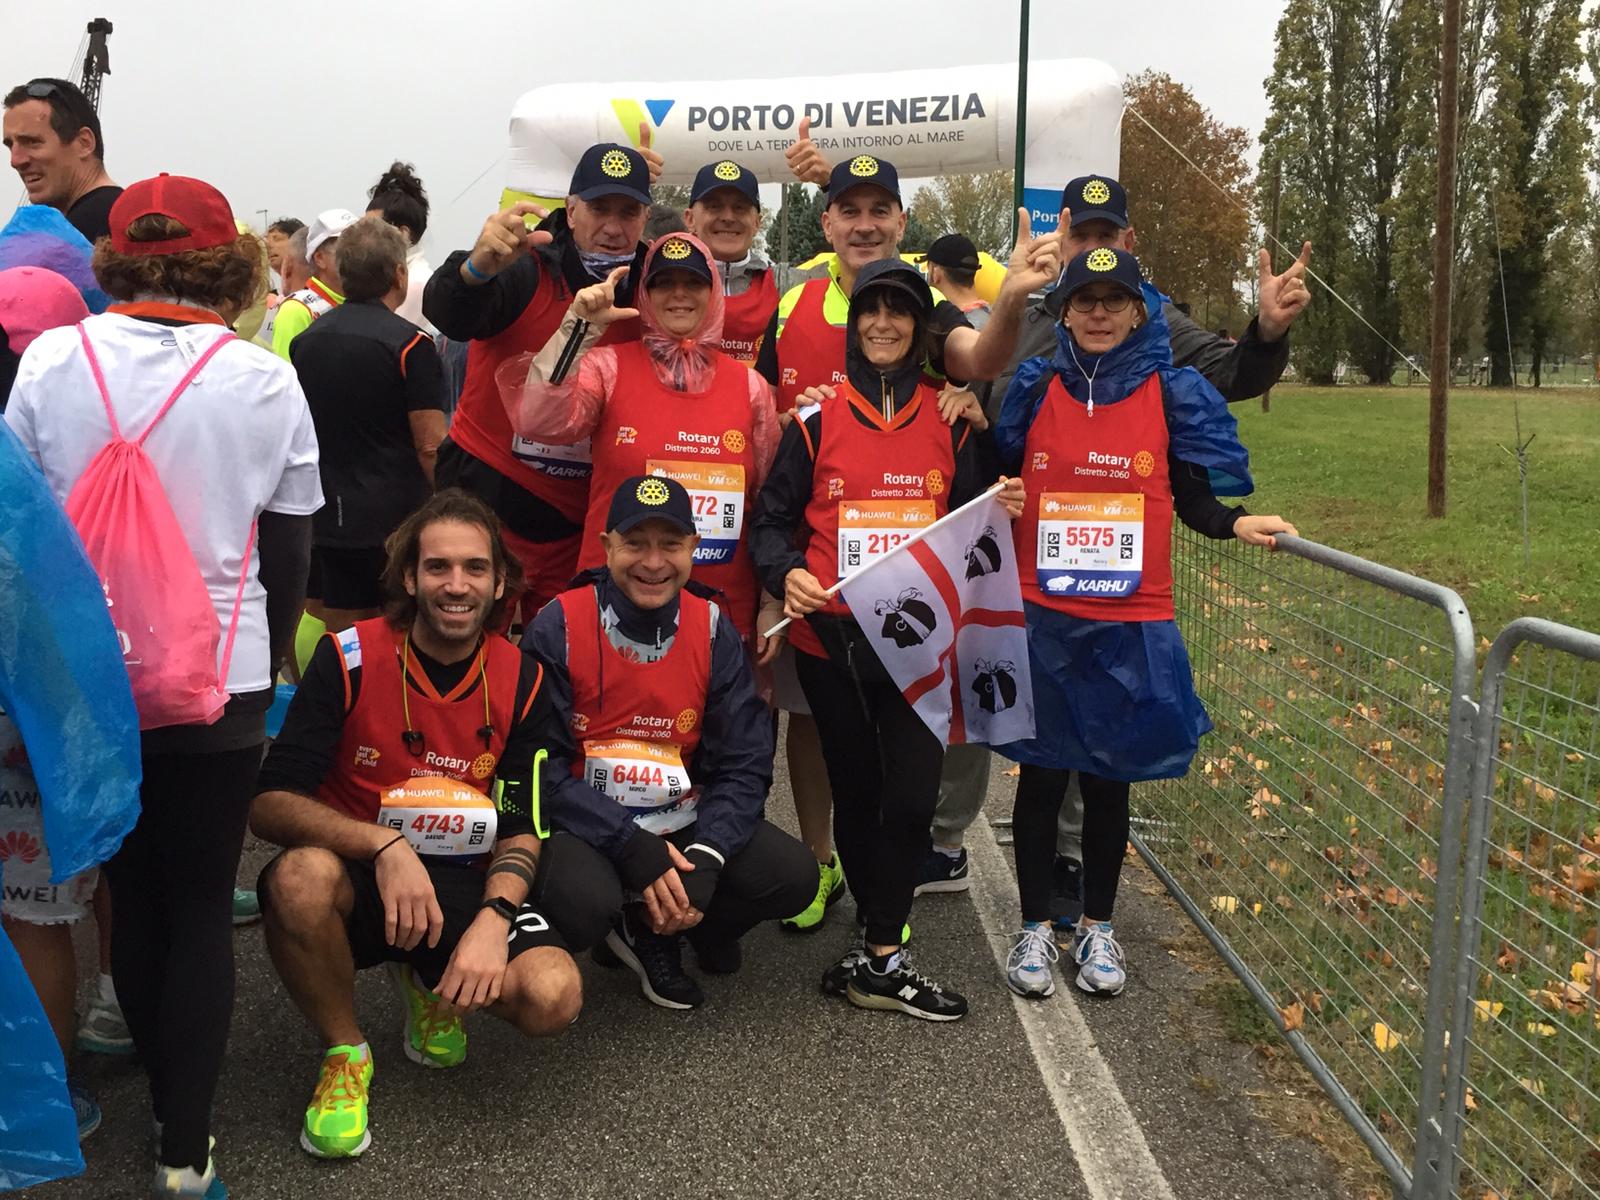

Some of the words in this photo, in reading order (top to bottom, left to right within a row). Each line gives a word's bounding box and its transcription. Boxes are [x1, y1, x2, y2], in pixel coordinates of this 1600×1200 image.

[688, 104, 795, 132] PORTO
[804, 102, 833, 129] DI
[842, 93, 986, 127] VENEZIA
[708, 140, 744, 152] DOVE
[747, 140, 764, 151] LA
[766, 138, 797, 150] TERR
[843, 134, 903, 148] INTORNO
[907, 133, 923, 145] AL
[927, 130, 964, 143] MARE
[678, 431, 720, 446] Rotary
[665, 443, 698, 453] Distretto
[700, 446, 720, 455] 2060
[1088, 451, 1131, 469] Rotary
[668, 471, 701, 481] HUAWEI
[1074, 467, 1107, 476] Distretto
[1109, 469, 1130, 479] 2060
[883, 473, 924, 487] Rotary
[871, 489, 903, 497] Distretto
[905, 488, 924, 497] 2060
[689, 494, 718, 515] 72
[1060, 502, 1096, 512] HUAWEI
[861, 511, 896, 519] HUAWEI
[1066, 527, 1114, 547] 5575
[692, 548, 728, 560] ARHU
[1076, 579, 1128, 592] KARHU
[632, 715, 675, 728] Rotary
[615, 727, 649, 737] Distretto
[651, 730, 672, 738] 2060
[425, 751, 471, 772] Rotary
[613, 764, 664, 786] 6444
[407, 788, 444, 798] HUAWEI
[411, 814, 465, 835] 4743
